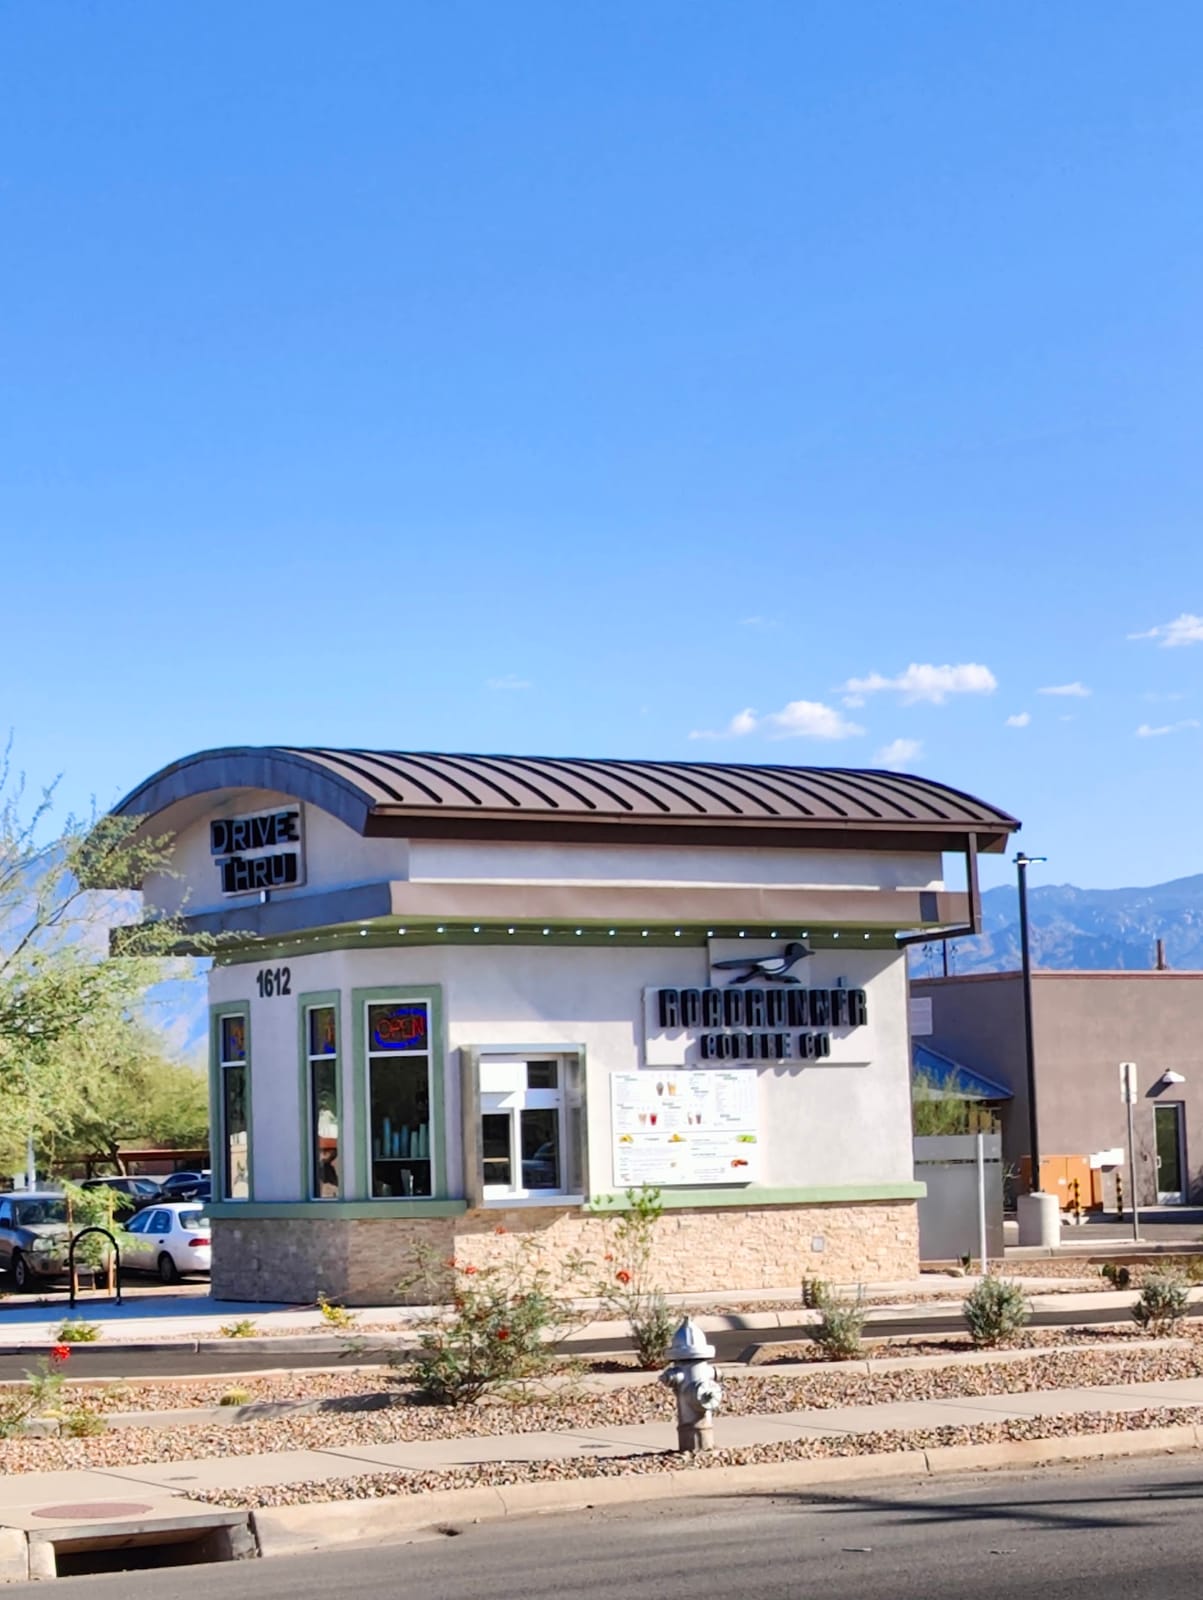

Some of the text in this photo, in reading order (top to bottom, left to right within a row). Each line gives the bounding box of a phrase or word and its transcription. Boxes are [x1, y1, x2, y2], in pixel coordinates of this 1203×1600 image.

[210, 812, 299, 855] DRIVE
[214, 854, 297, 892] THRU
[256, 967, 291, 998] 1612
[658, 989, 867, 1027] ROADRUNNER
[376, 1015, 424, 1039] OPEN
[799, 1033, 830, 1058] CO
